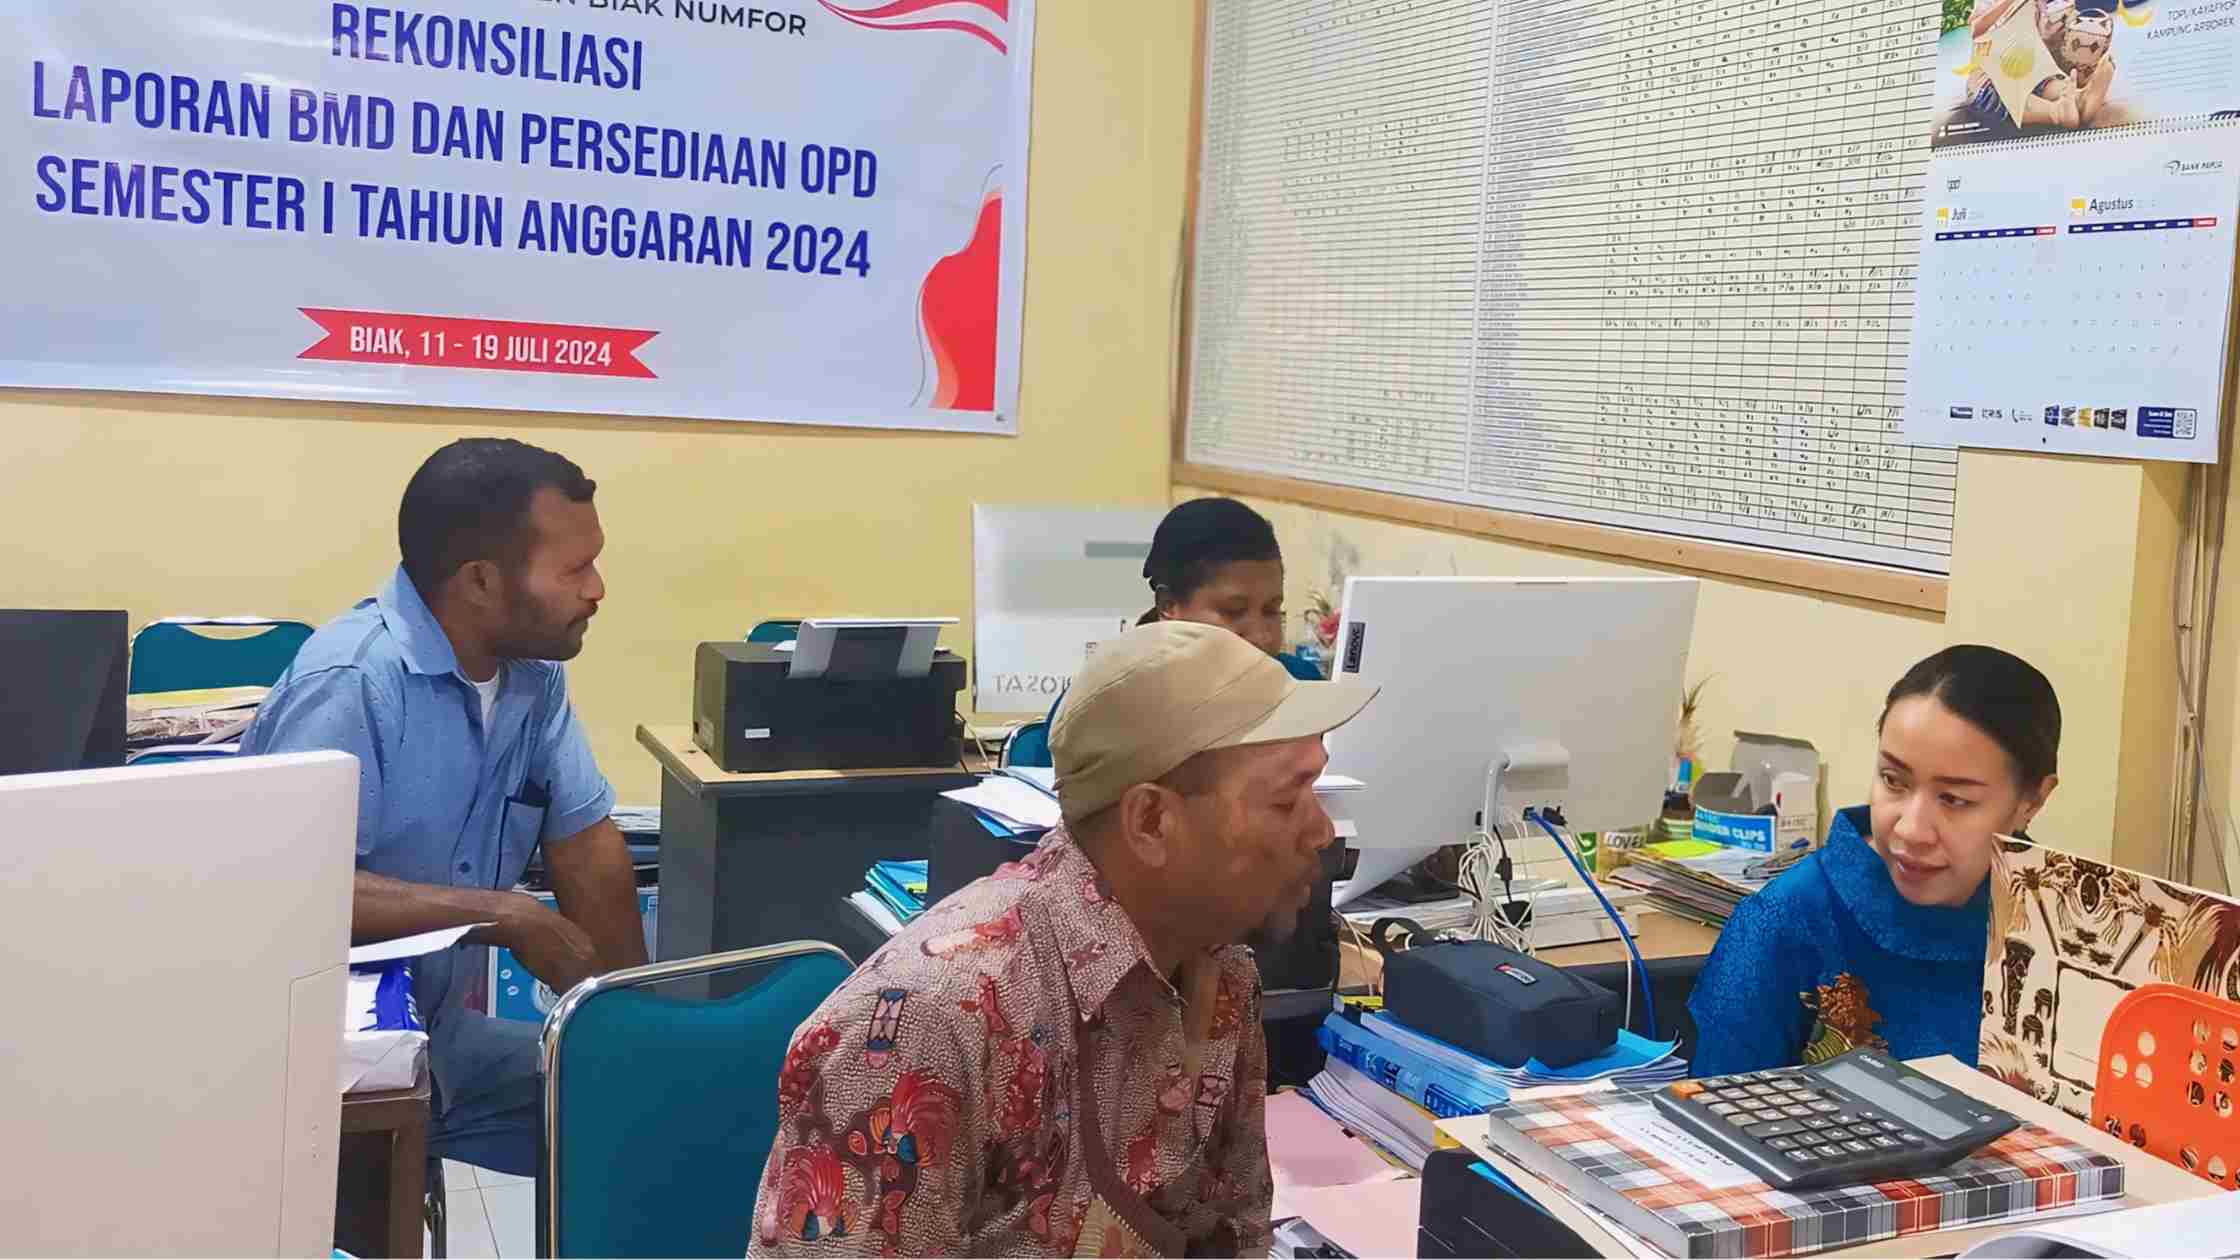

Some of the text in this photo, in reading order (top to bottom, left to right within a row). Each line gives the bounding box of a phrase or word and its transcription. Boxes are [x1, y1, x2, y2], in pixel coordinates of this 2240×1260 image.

[332, 2, 642, 91] REKONSILIASI
[673, 0, 807, 37] NUMFOR
[33, 61, 877, 198] LAPORAN BMD DAN PERSEDIAAN OPD
[36, 154, 871, 278] SEMESTER I TAHUN ANGGARAN 2024
[2089, 197, 2134, 215] Agustus
[350, 325, 410, 358] BIAK,
[420, 331, 445, 357] 11
[472, 334, 496, 360] 19
[504, 336, 548, 363] JULI
[554, 339, 612, 367] 2024
